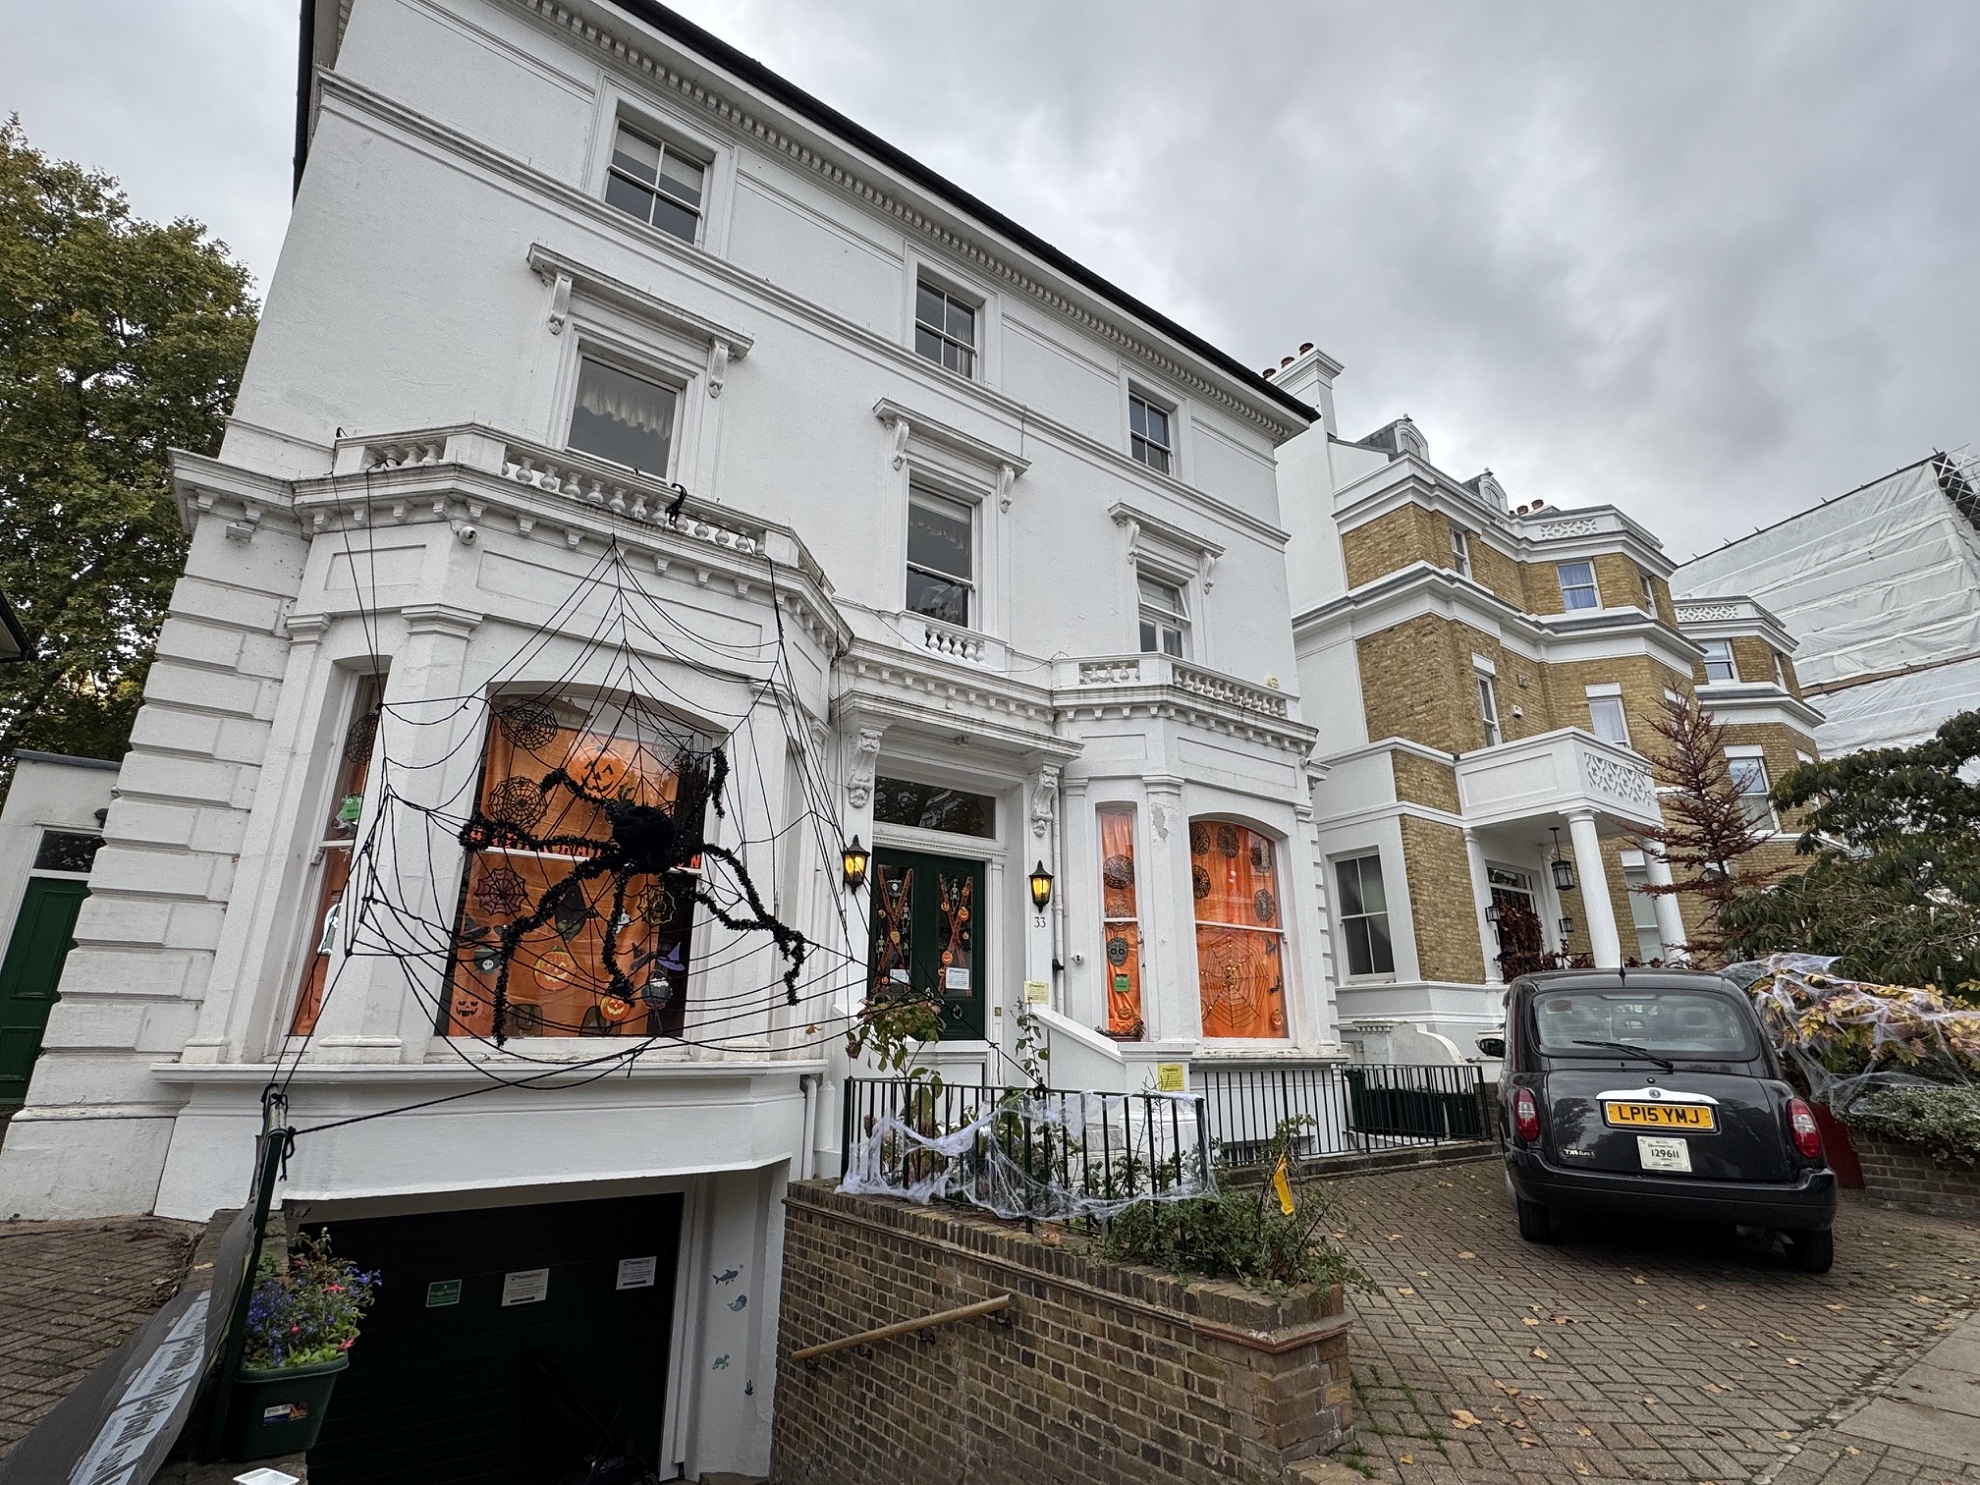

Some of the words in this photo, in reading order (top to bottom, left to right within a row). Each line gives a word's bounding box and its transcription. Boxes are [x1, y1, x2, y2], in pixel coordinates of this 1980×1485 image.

[1034, 916, 1046, 928] 33
[1618, 1105, 1659, 1122] LP15
[1663, 1108, 1700, 1124] YMJ
[1651, 1149, 1680, 1159] 129611
